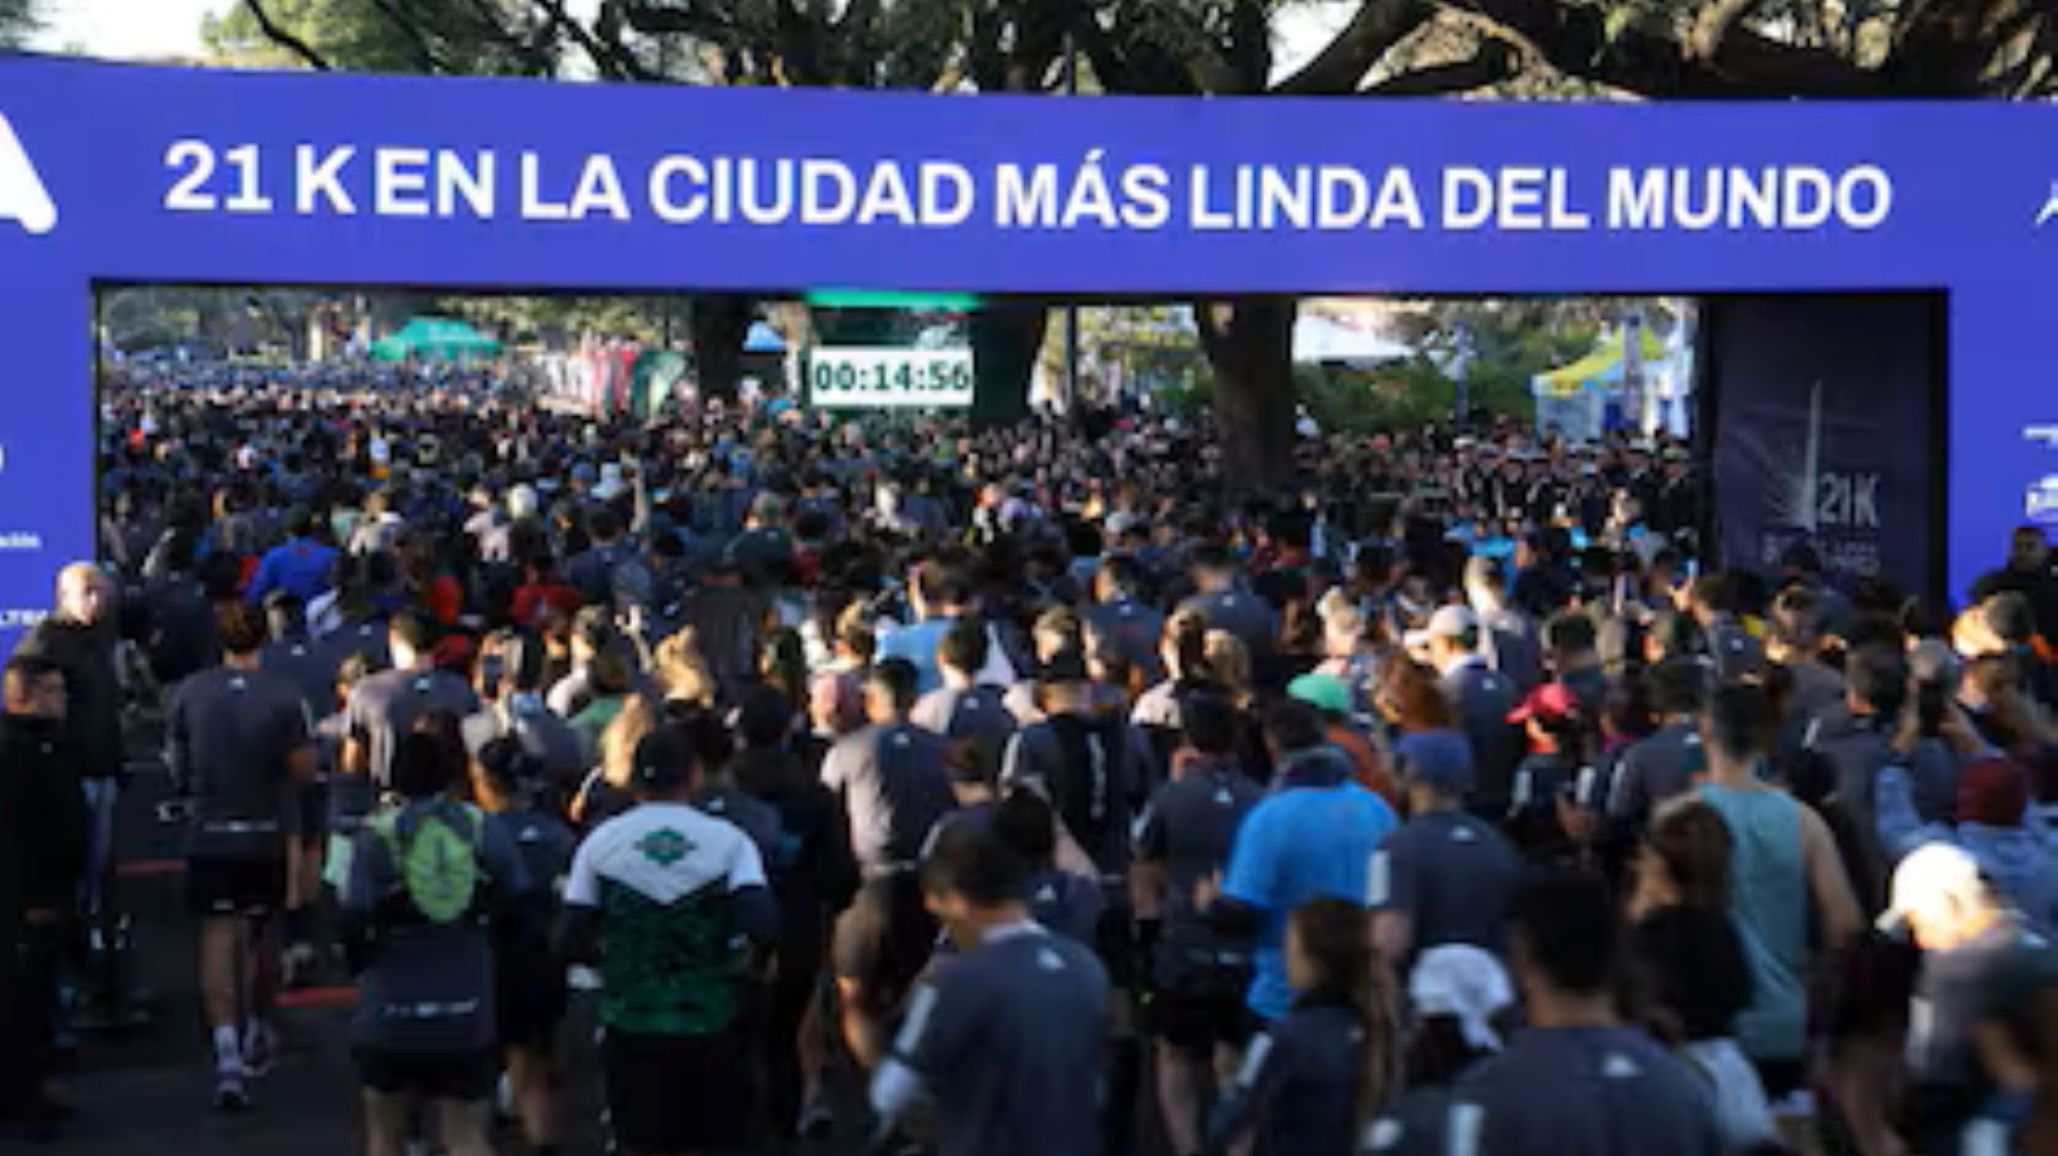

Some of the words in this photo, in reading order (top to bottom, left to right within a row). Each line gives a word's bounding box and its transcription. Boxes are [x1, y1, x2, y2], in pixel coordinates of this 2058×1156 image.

[165, 140, 273, 212] 21
[297, 145, 356, 215] K
[376, 148, 495, 218] EN
[521, 152, 632, 221] LA
[649, 155, 974, 226] CIUDAD
[995, 148, 1170, 229] MÁS
[1190, 165, 1423, 229] LINDA
[1442, 167, 1590, 229] DEL
[1608, 165, 1892, 229] MUNDO
[814, 359, 971, 392] 00:14:56
